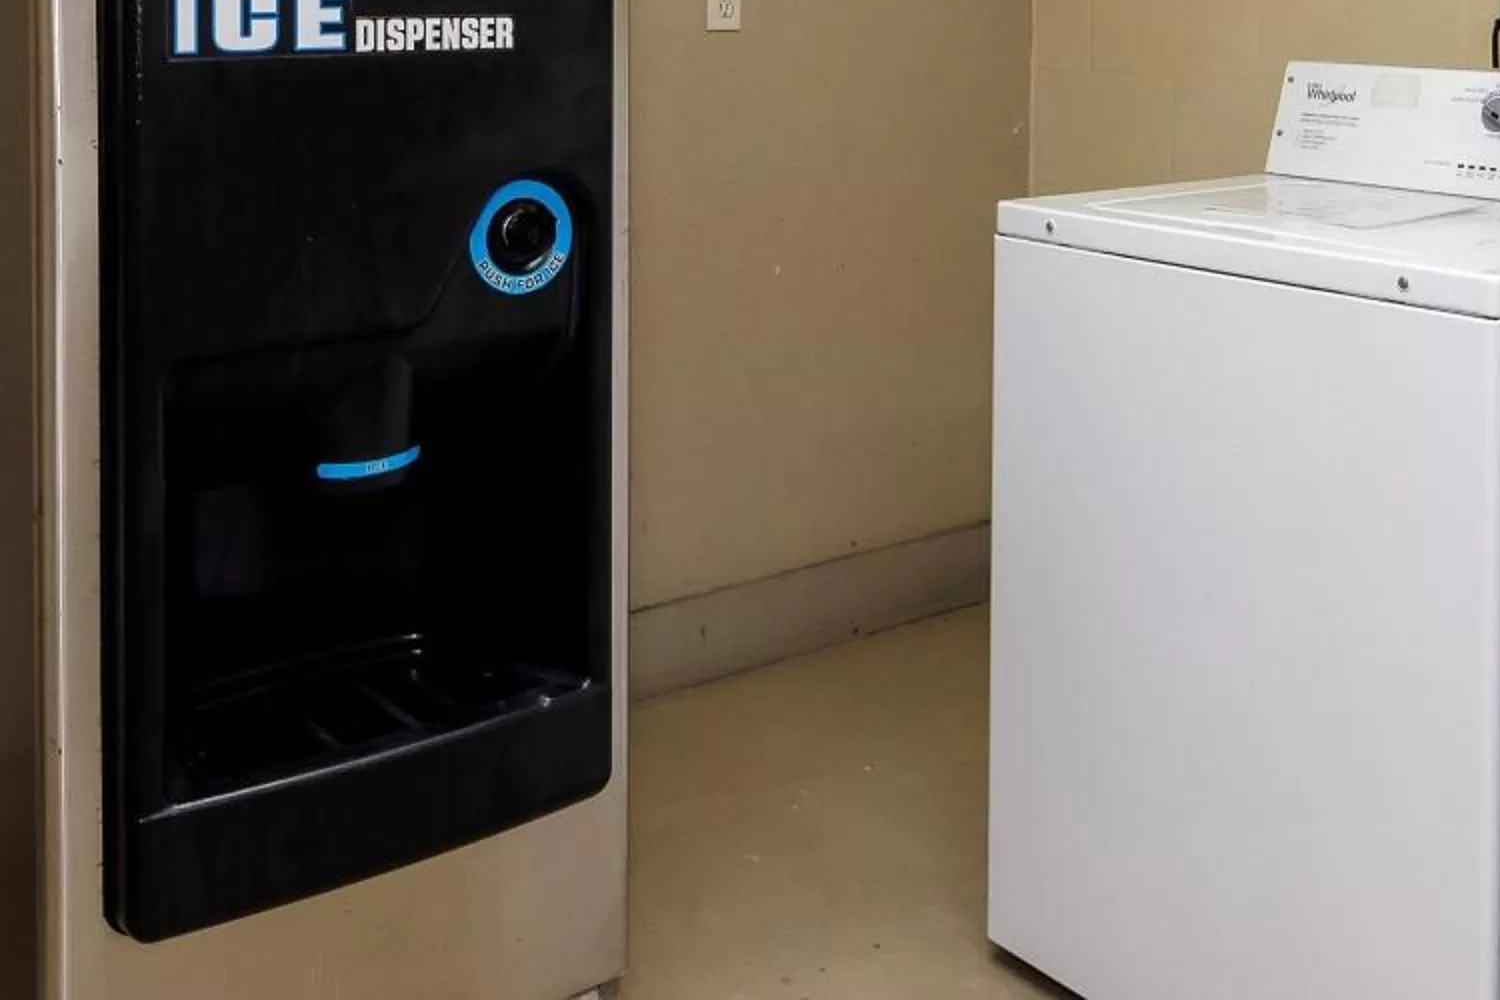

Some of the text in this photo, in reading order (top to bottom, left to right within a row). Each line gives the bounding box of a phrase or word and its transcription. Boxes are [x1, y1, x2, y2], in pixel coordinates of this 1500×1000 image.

[355, 16, 515, 53] DISPENSER
[1307, 87, 1357, 104] Whirlpool
[480, 260, 511, 289] PUSH
[517, 272, 544, 289] FOR
